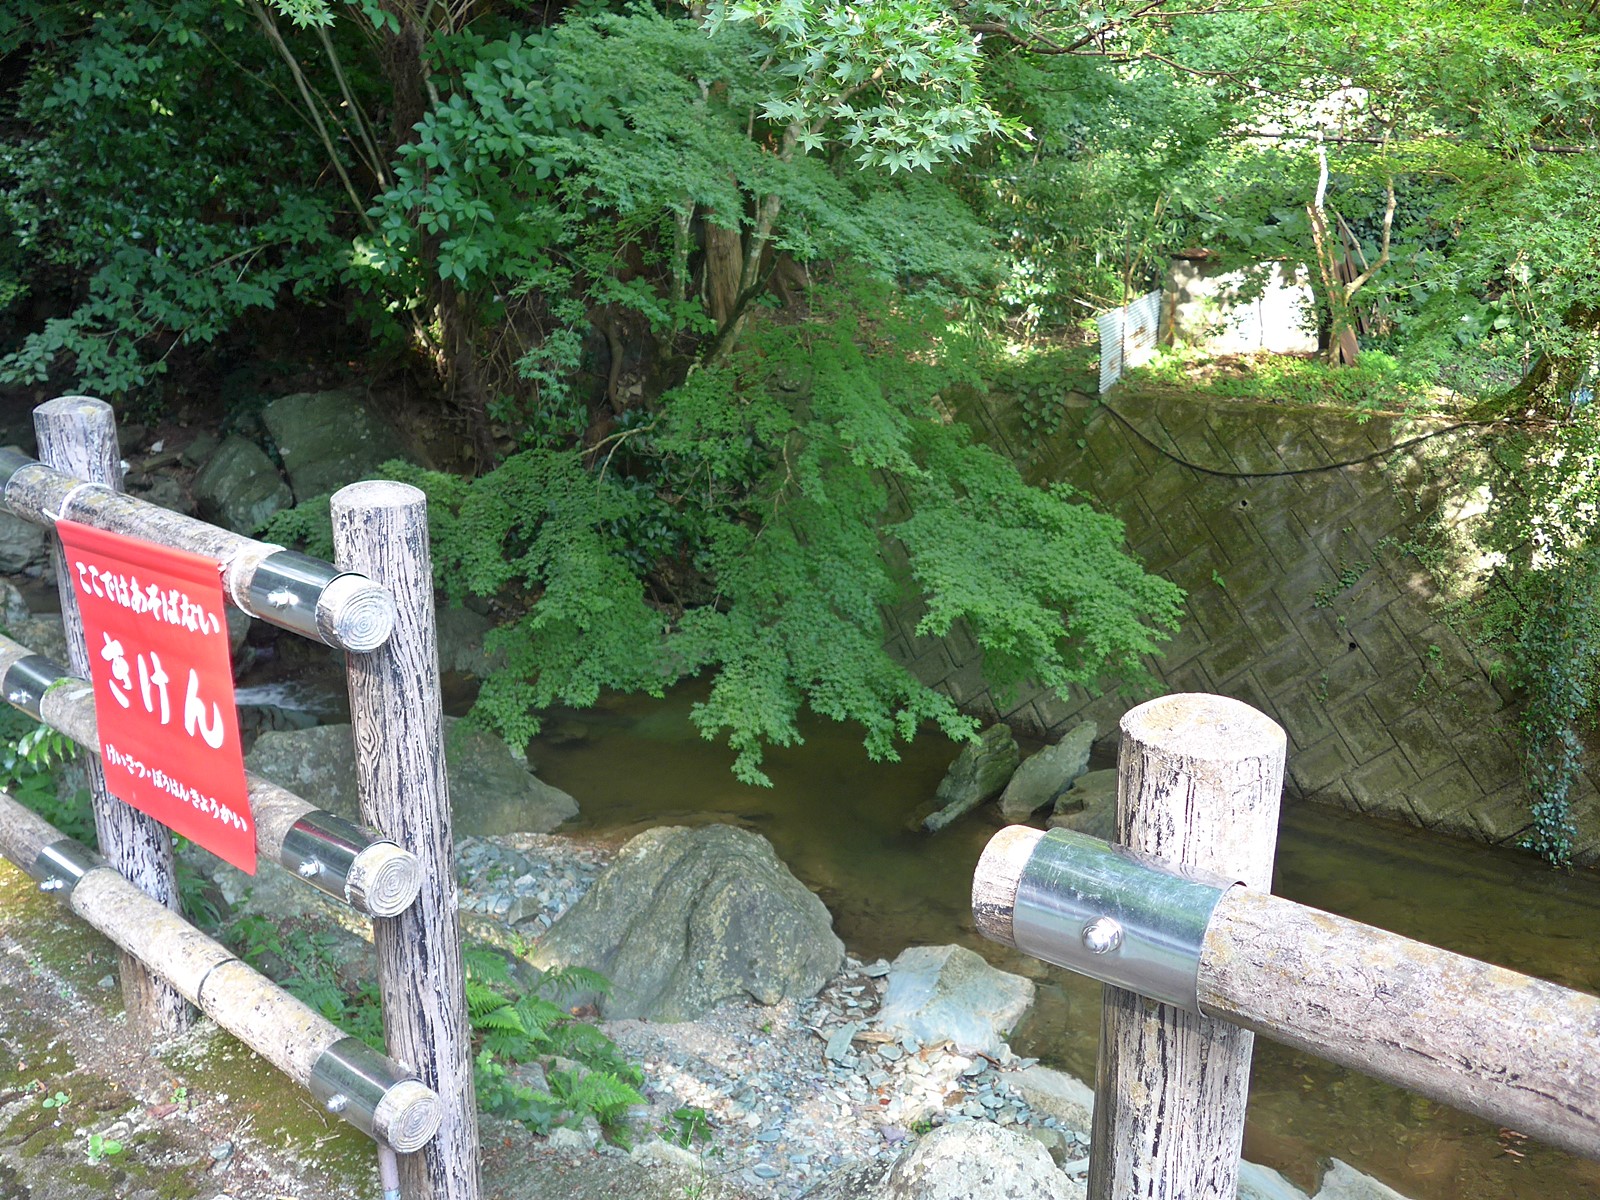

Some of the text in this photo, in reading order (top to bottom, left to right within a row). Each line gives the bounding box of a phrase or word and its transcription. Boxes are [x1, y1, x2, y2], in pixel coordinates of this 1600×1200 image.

[75, 561, 220, 635] ここではあそばない
[101, 631, 224, 749] きけん
